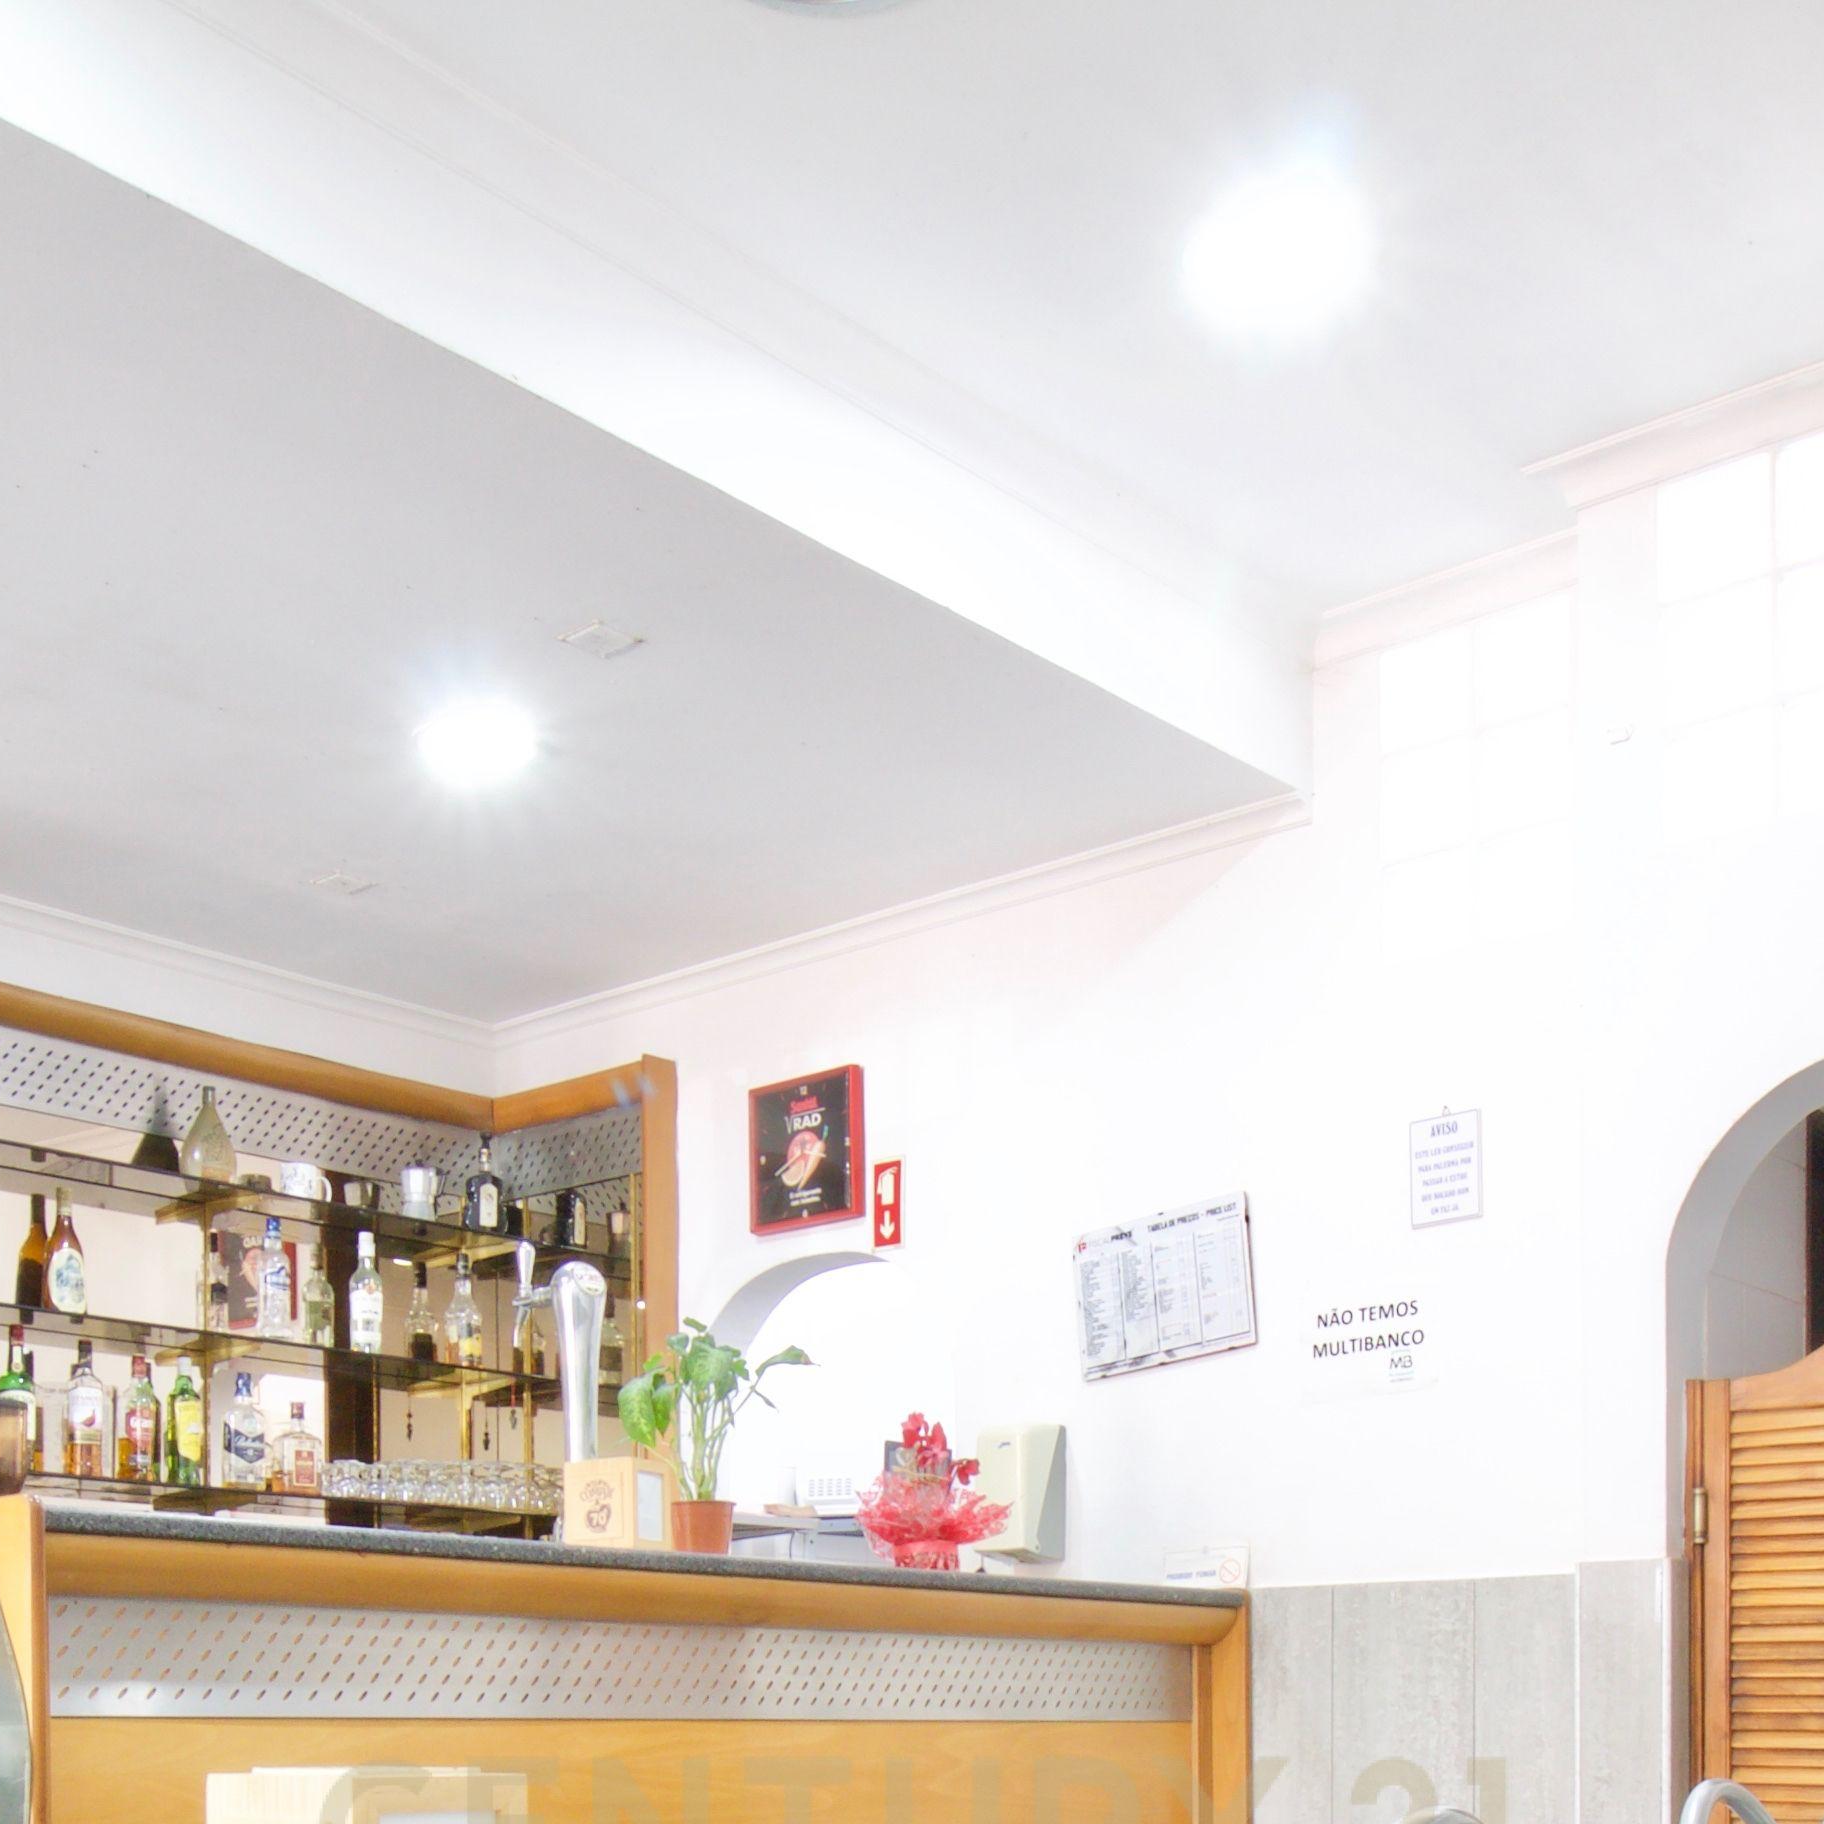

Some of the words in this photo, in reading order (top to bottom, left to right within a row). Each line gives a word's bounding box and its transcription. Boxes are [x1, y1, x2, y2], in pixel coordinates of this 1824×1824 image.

[1317, 1308, 1353, 1328] NÃO
[1358, 1300, 1419, 1322] TEMOS
[1313, 1329, 1424, 1359] MULTIBANCO
[1389, 1355, 1413, 1369] MB
